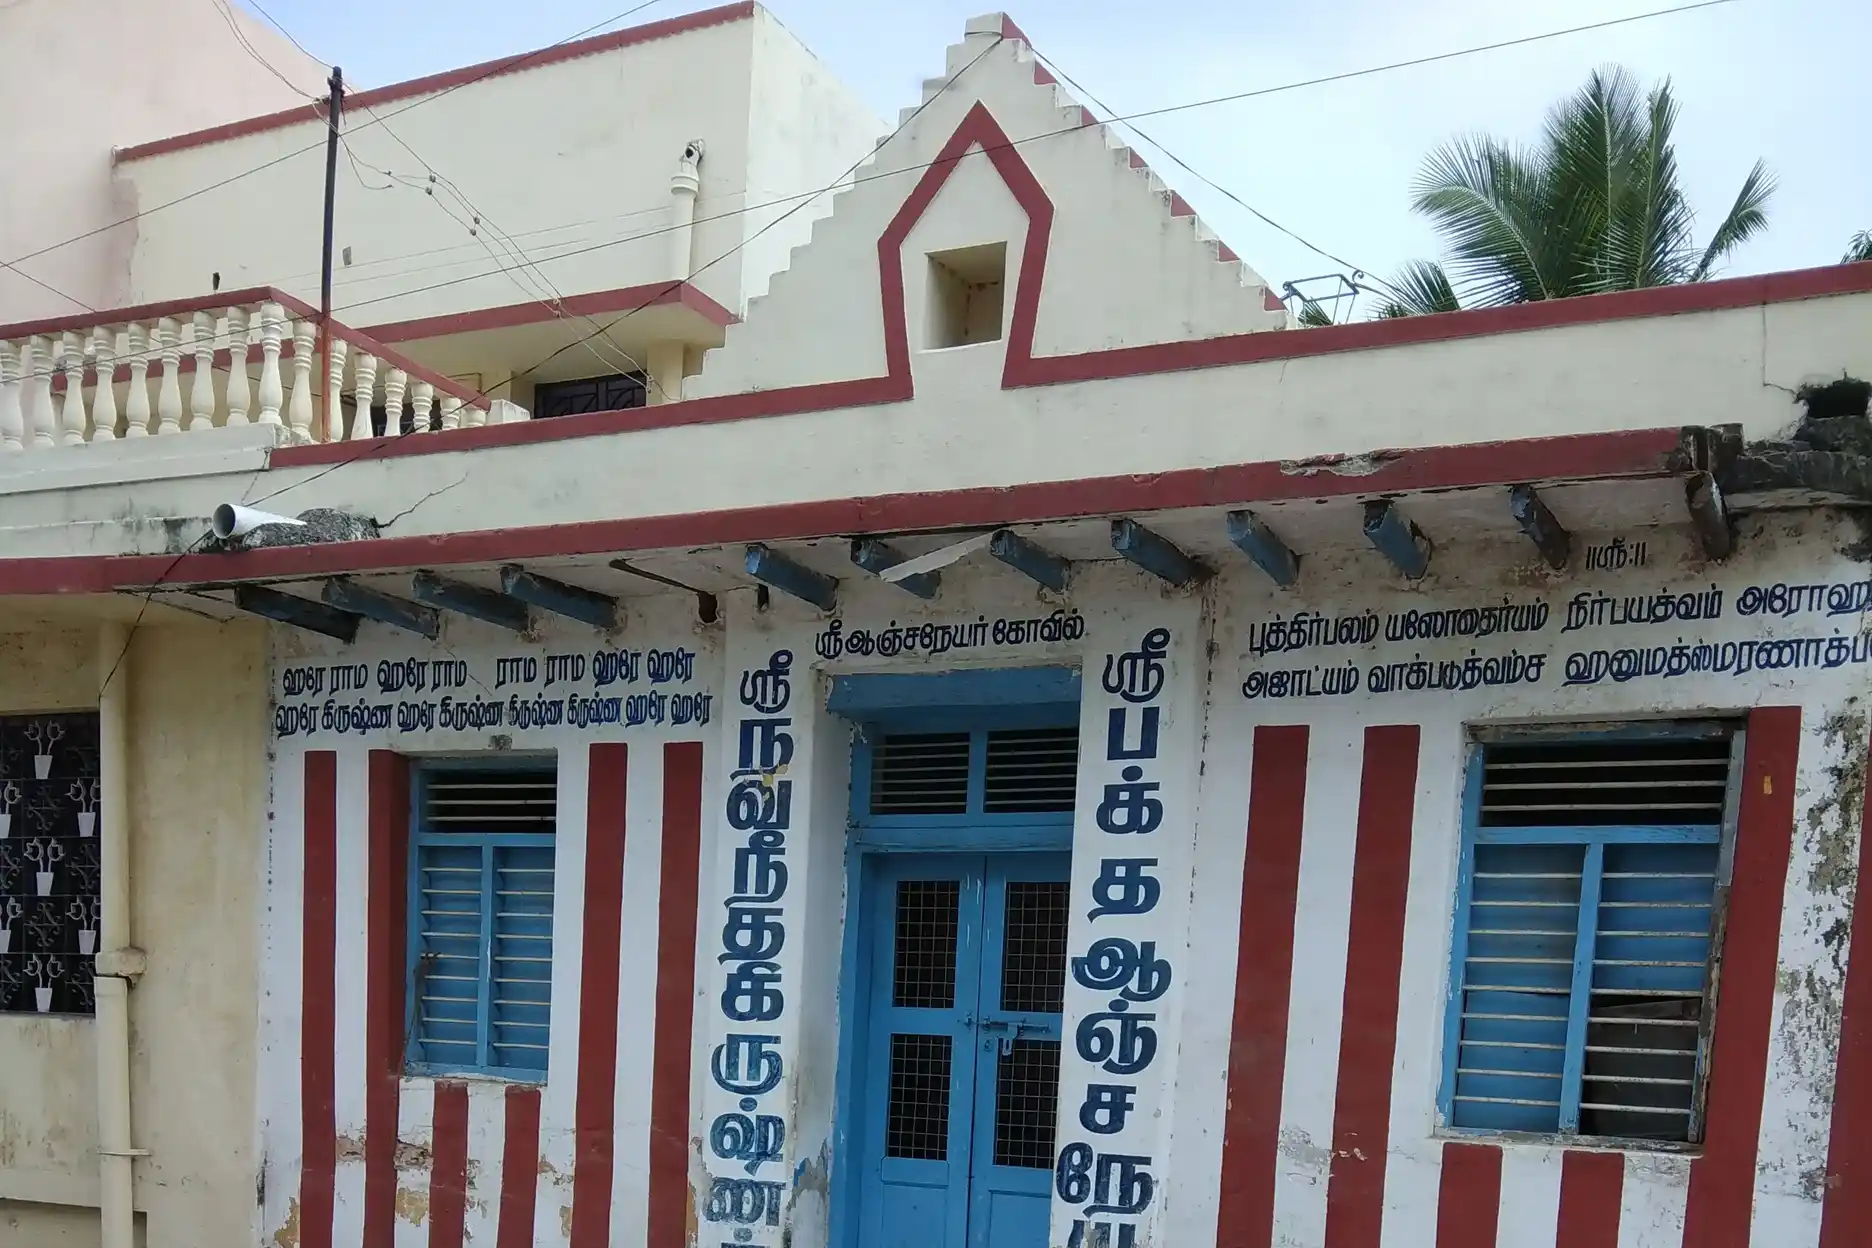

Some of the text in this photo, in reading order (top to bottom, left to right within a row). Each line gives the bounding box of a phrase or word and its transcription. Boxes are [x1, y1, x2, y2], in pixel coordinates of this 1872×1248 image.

[992, 608, 1085, 646] கோவில்
[1560, 583, 1723, 634] நிர்பயத்வம்
[1736, 576, 1872, 619] அரோஹ
[282, 646, 695, 698] ஹரே ராம ஹரே ராம ராம ராம ஹரே ஹரே
[1242, 659, 1360, 699] அஜாட்யம்
[276, 702, 319, 740] ஹரே
[397, 701, 437, 733] ஹரே
[625, 690, 668, 727] ஹரே
[671, 691, 713, 728] ஹரே
